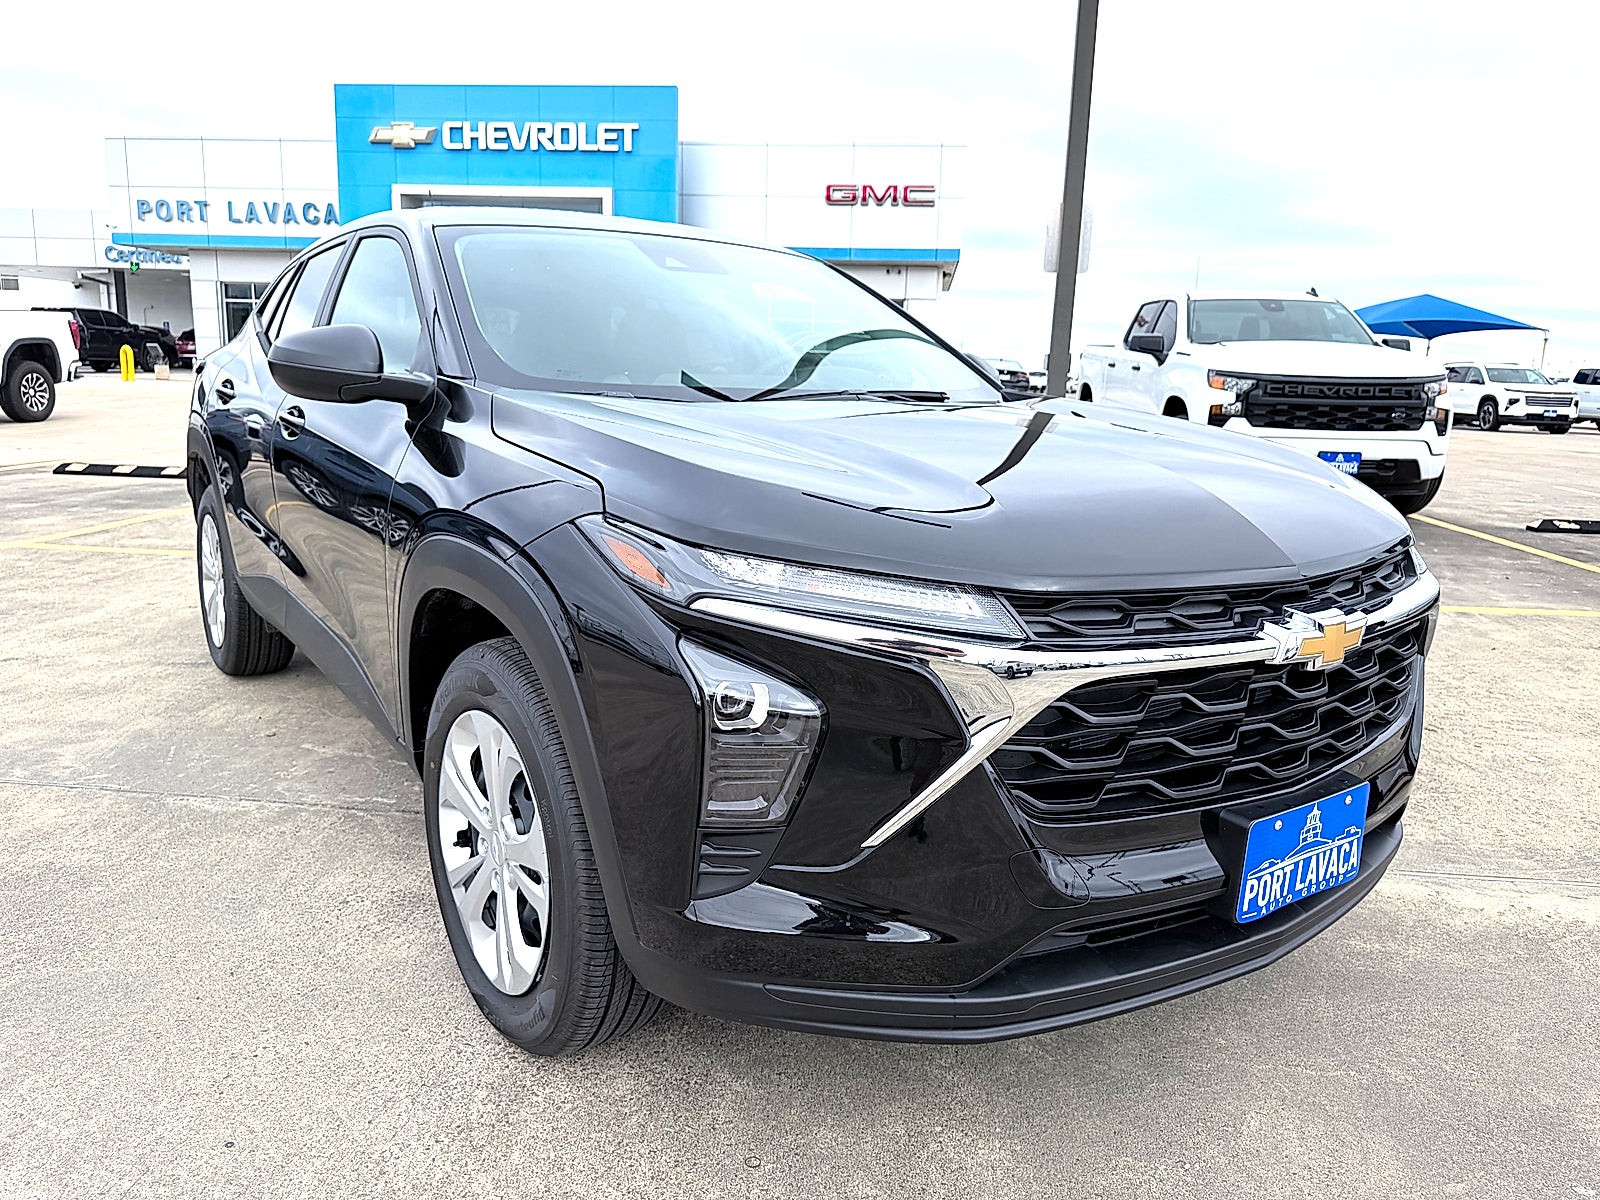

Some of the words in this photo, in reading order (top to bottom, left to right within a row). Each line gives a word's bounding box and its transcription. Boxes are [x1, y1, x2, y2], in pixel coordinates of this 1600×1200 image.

[442, 120, 639, 152] CHEVROLET
[825, 184, 936, 207] GMC
[136, 199, 209, 222] PORT
[228, 201, 339, 225] LAVACA
[1266, 383, 1421, 398] CHEVROLET
[1242, 863, 1295, 913] PORT
[1295, 839, 1359, 892] LAVACA
[1261, 894, 1293, 917] AUTO
[1301, 875, 1344, 897] GROUP
